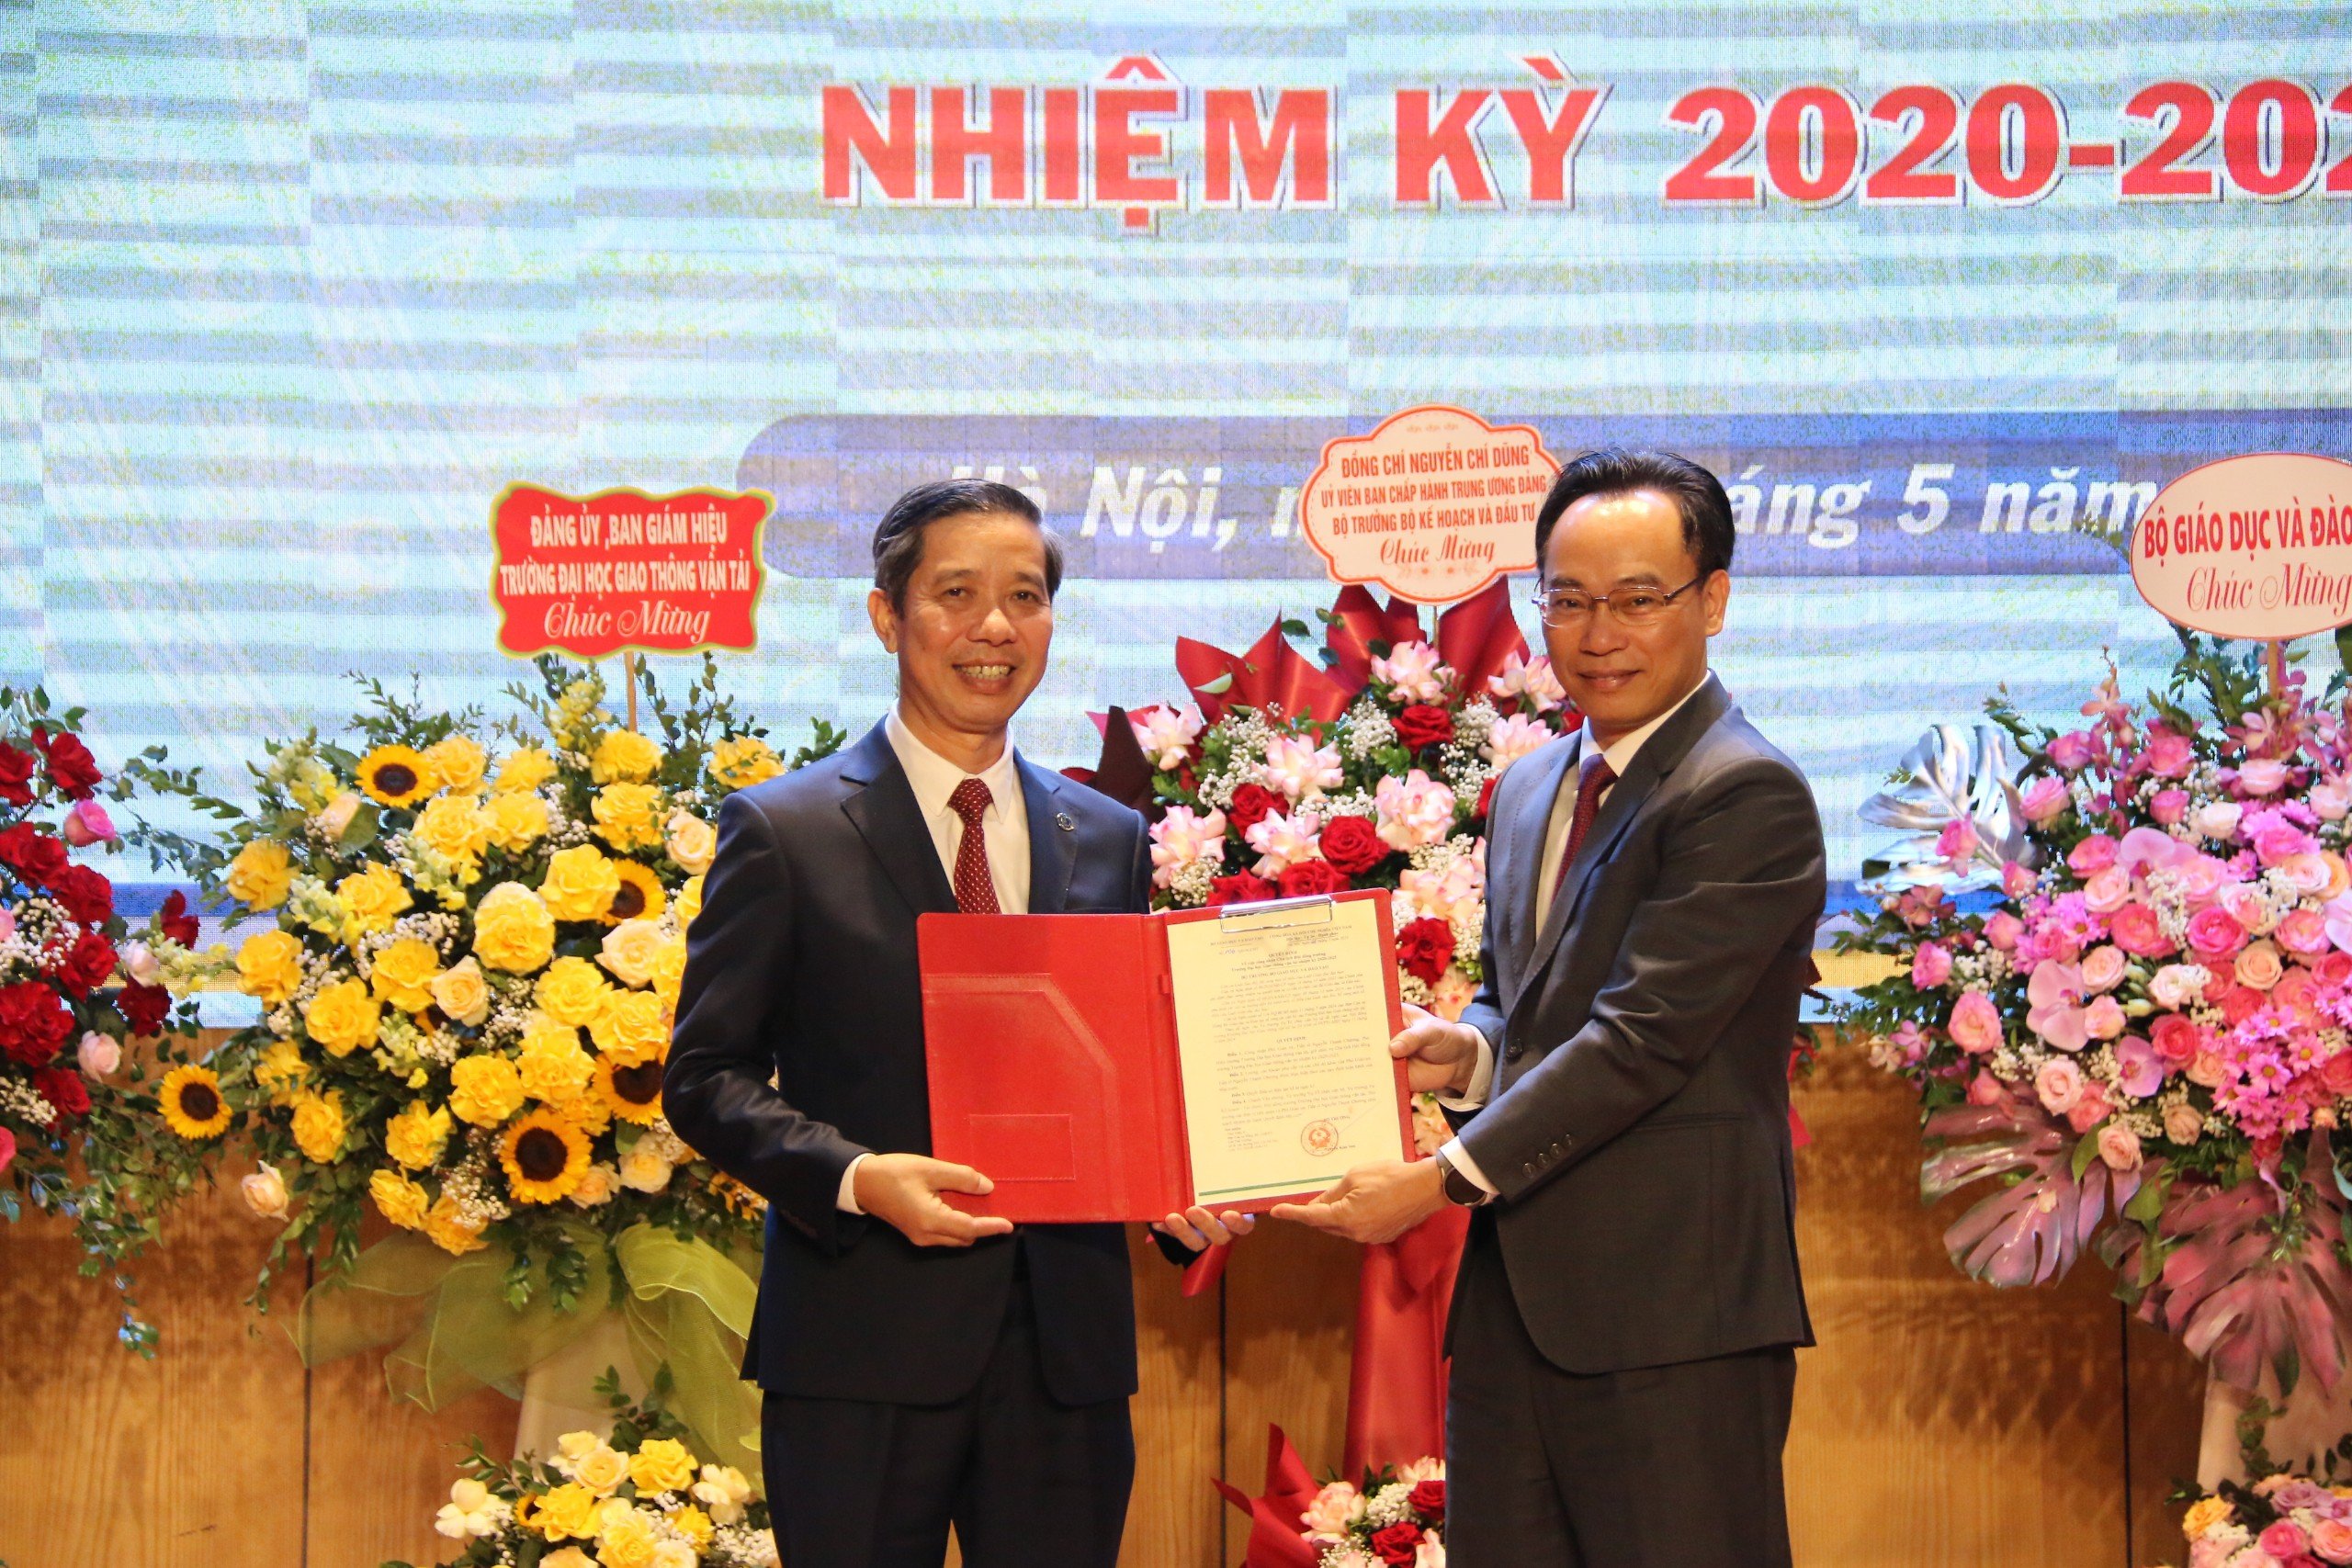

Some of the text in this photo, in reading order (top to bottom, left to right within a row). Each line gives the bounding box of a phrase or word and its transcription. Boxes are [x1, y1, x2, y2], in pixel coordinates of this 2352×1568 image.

[821, 55, 2352, 230] NHIỆM KỲ 2020-20
[1341, 442, 1530, 479] ĐỒNG CHÍ NGUYỄN CHÍ DŨNG
[1080, 466, 1238, 554] Nội,
[1725, 463, 1873, 549] áng
[1897, 463, 1955, 535] 5
[1978, 466, 2157, 535] năm
[1337, 484, 1362, 507] VIÊN
[1364, 486, 1387, 505] BAN
[1389, 477, 1417, 503] CHẤP
[1419, 478, 1449, 502] HÀNH
[1451, 479, 1485, 499] TRUNG
[1487, 476, 1516, 496] ƯƠNG
[1518, 469, 1547, 494] ĐẢNG
[530, 503, 577, 547] ĐẢNG
[579, 503, 601, 547] ỦY
[646, 503, 688, 545] GIÁM
[691, 502, 728, 552] HIỆU
[1332, 499, 1536, 539] BỘ TRƯỞNG BỘ KẾ HOẠCH VÀ ĐẦU TƯ
[2144, 493, 2352, 568] BỘ GIÁO DỤC VÀ ĐÀO
[500, 548, 750, 602] TRƯỜNG ĐẠI HỌC GIAO THÔNG VẬN TẢI
[1380, 534, 1496, 566] Chúc Mừng
[2187, 562, 2352, 618] Chúc Mừng
[544, 600, 710, 644] Chúc Mừng
